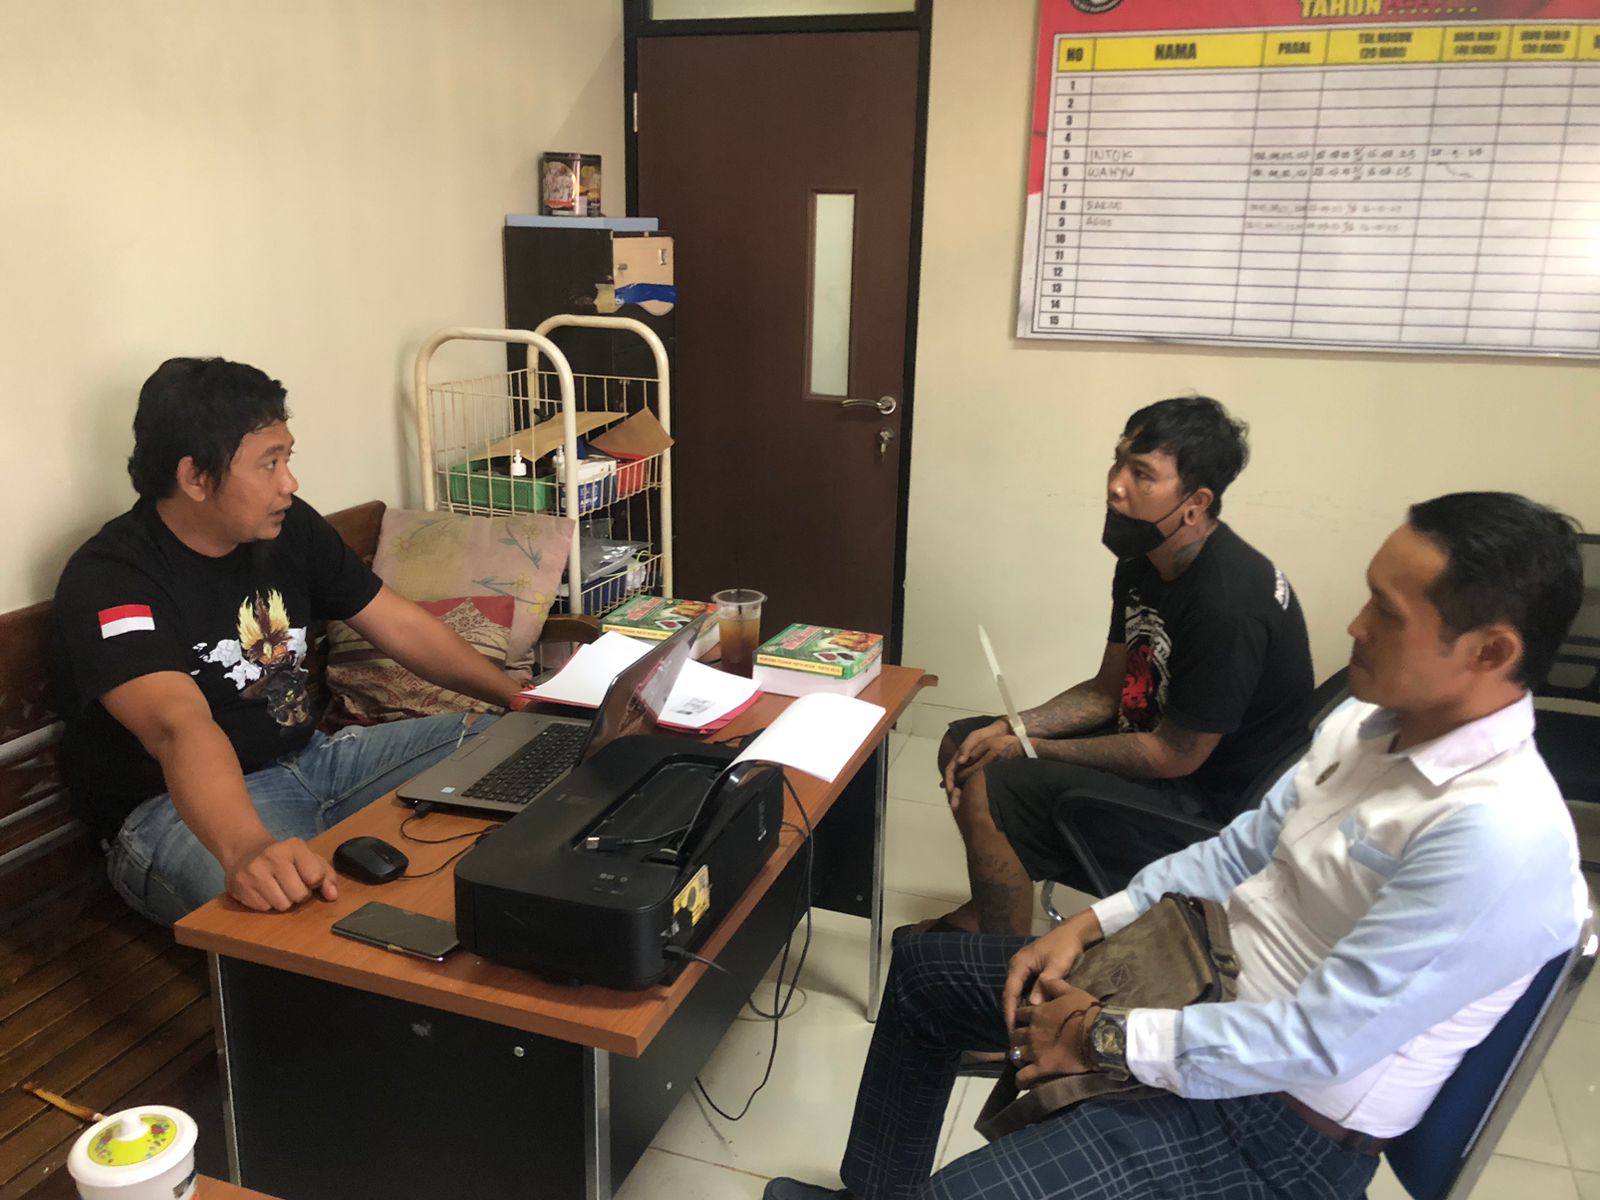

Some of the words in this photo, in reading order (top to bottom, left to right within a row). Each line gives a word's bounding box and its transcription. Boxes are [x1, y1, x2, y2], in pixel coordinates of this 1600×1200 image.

[1066, 48, 1084, 62] NO
[1154, 43, 1197, 61] NAMA
[1069, 80, 1076, 91] 1
[1067, 98, 1074, 109] 2
[1066, 115, 1073, 126] 3
[1065, 132, 1072, 143] 4
[1063, 149, 1070, 160] 5
[1062, 166, 1069, 177] 6
[1062, 183, 1068, 194] 7
[1060, 200, 1066, 211] 8
[1059, 217, 1065, 227] 9
[1056, 233, 1066, 244] 10
[1055, 250, 1064, 260] 11
[1053, 267, 1063, 277] 12
[1052, 283, 1062, 293] 13
[1051, 299, 1060, 309] 14
[1050, 315, 1059, 325] 15
